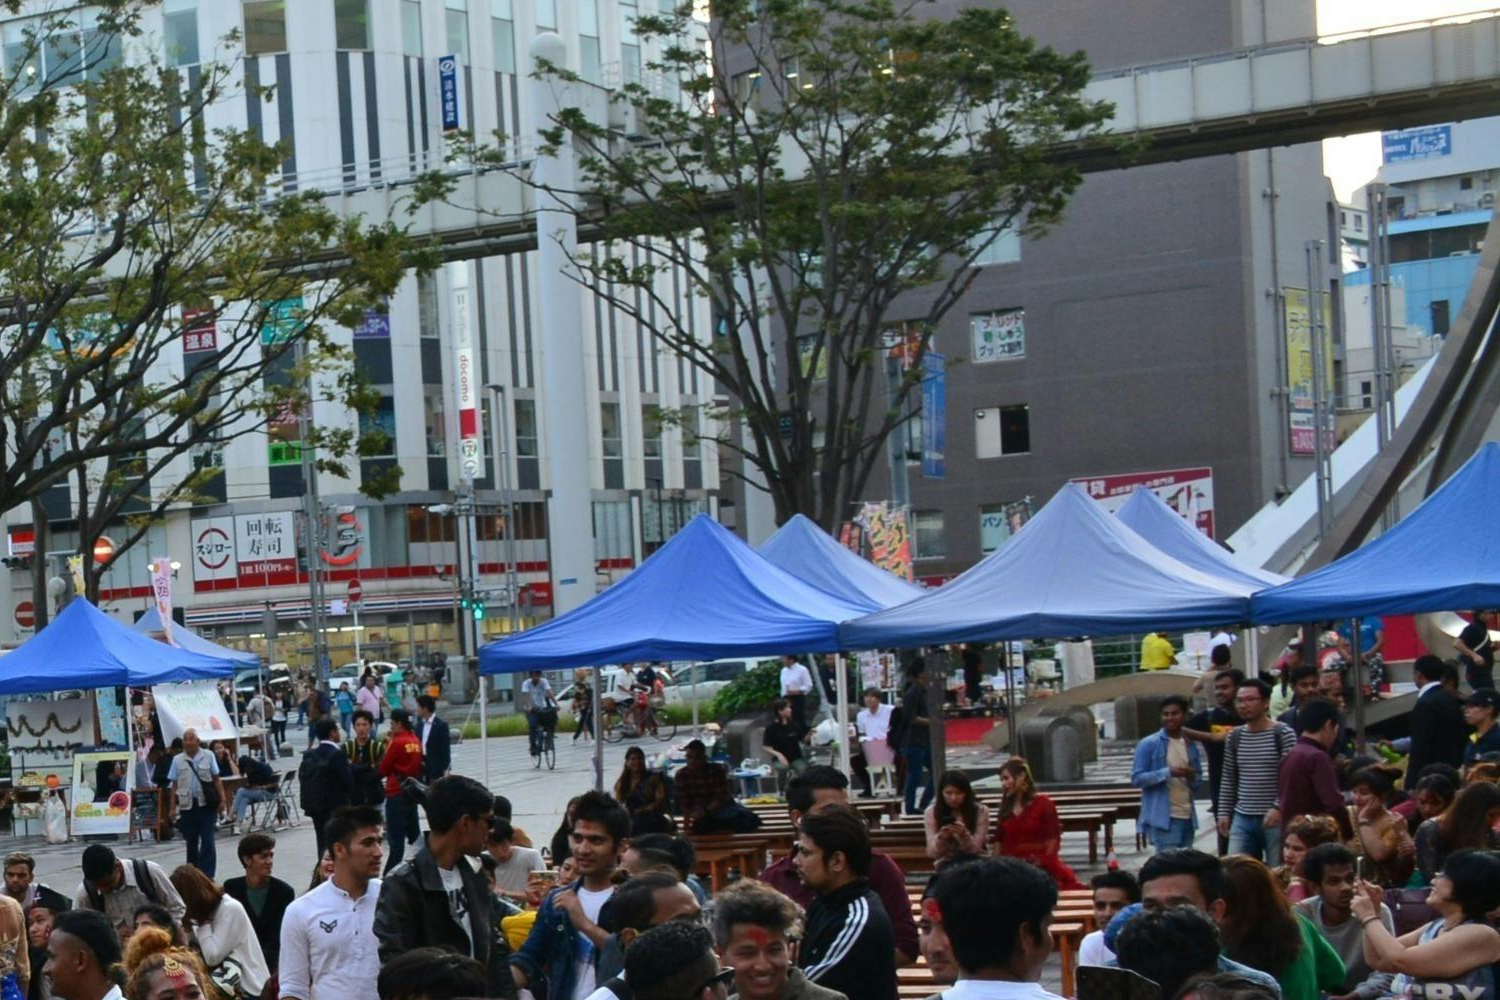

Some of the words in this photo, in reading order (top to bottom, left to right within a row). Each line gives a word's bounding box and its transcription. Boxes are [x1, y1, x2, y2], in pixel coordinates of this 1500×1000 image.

[186, 332, 215, 350] 温泉
[460, 355, 469, 402] docomo
[246, 517, 283, 537] 回転
[249, 538, 282, 556] 寿司
